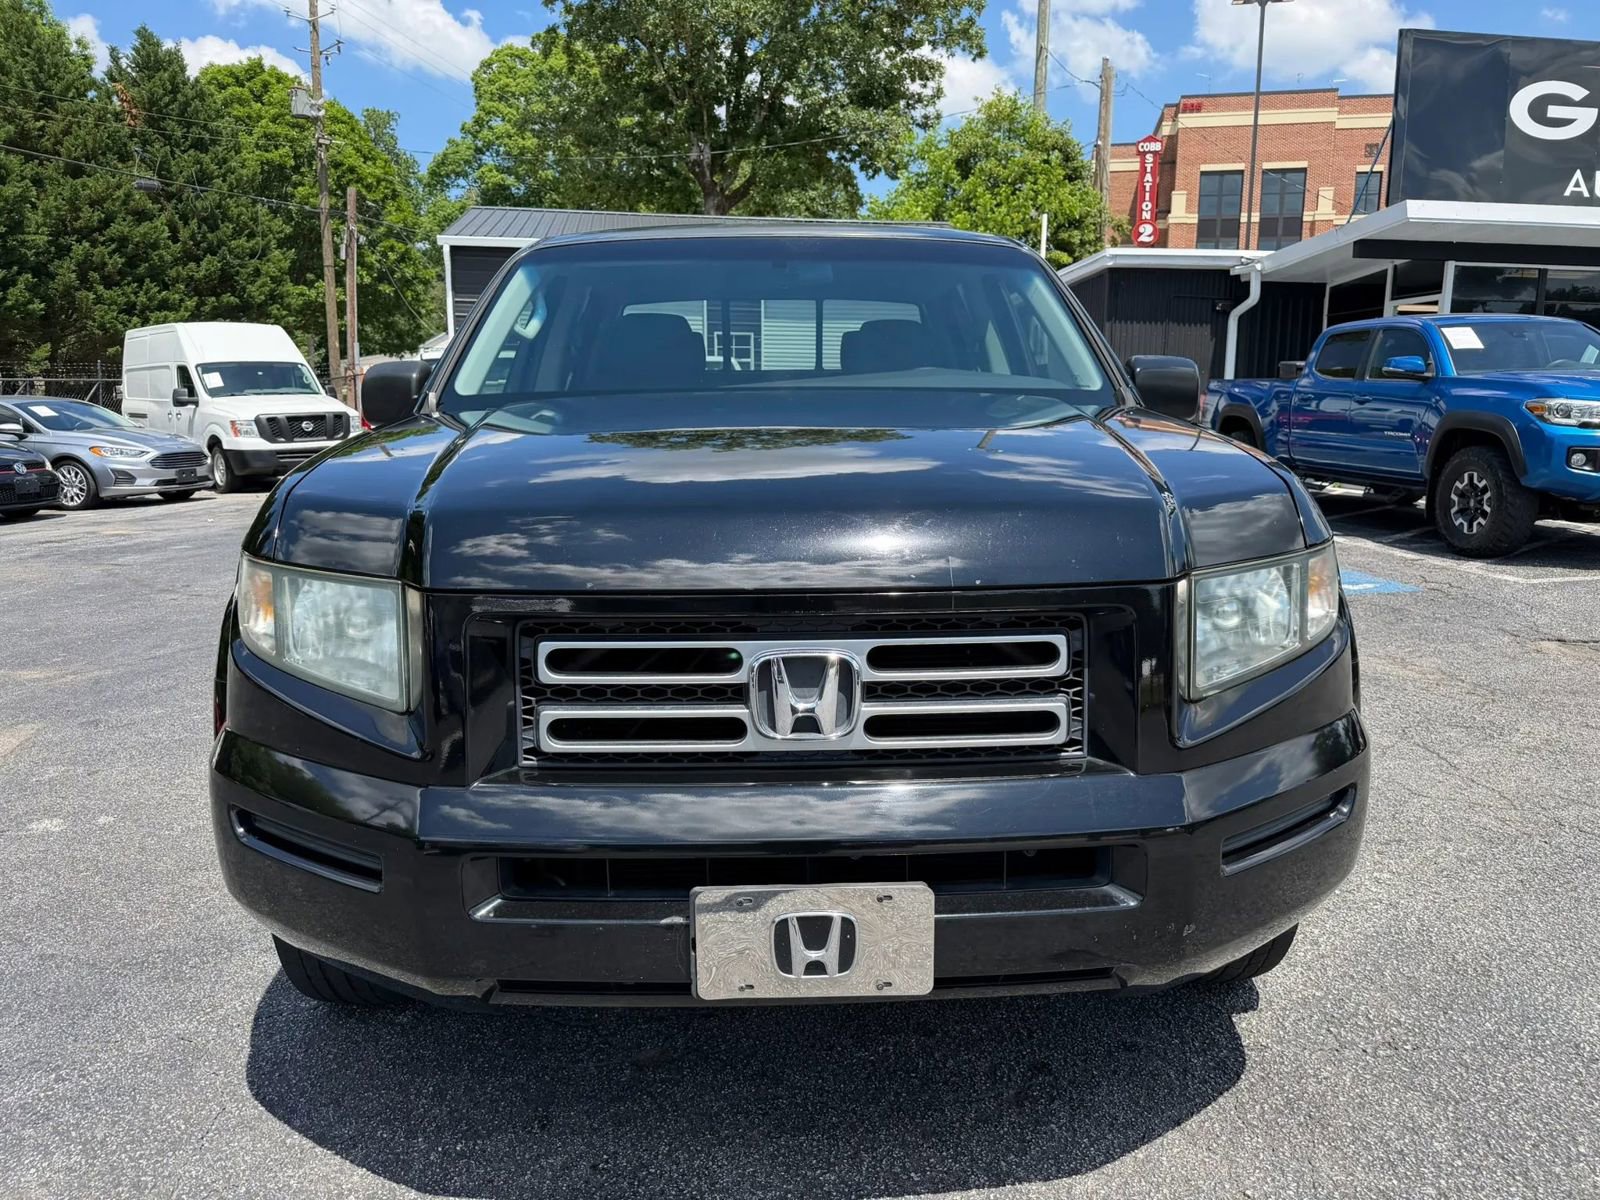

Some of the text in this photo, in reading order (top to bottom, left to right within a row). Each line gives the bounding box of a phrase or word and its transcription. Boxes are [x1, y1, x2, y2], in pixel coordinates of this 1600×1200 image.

[1509, 80, 1599, 140] G
[1138, 142, 1162, 152] COBB
[1141, 153, 1154, 220] STATION
[1137, 223, 1154, 243] 2
